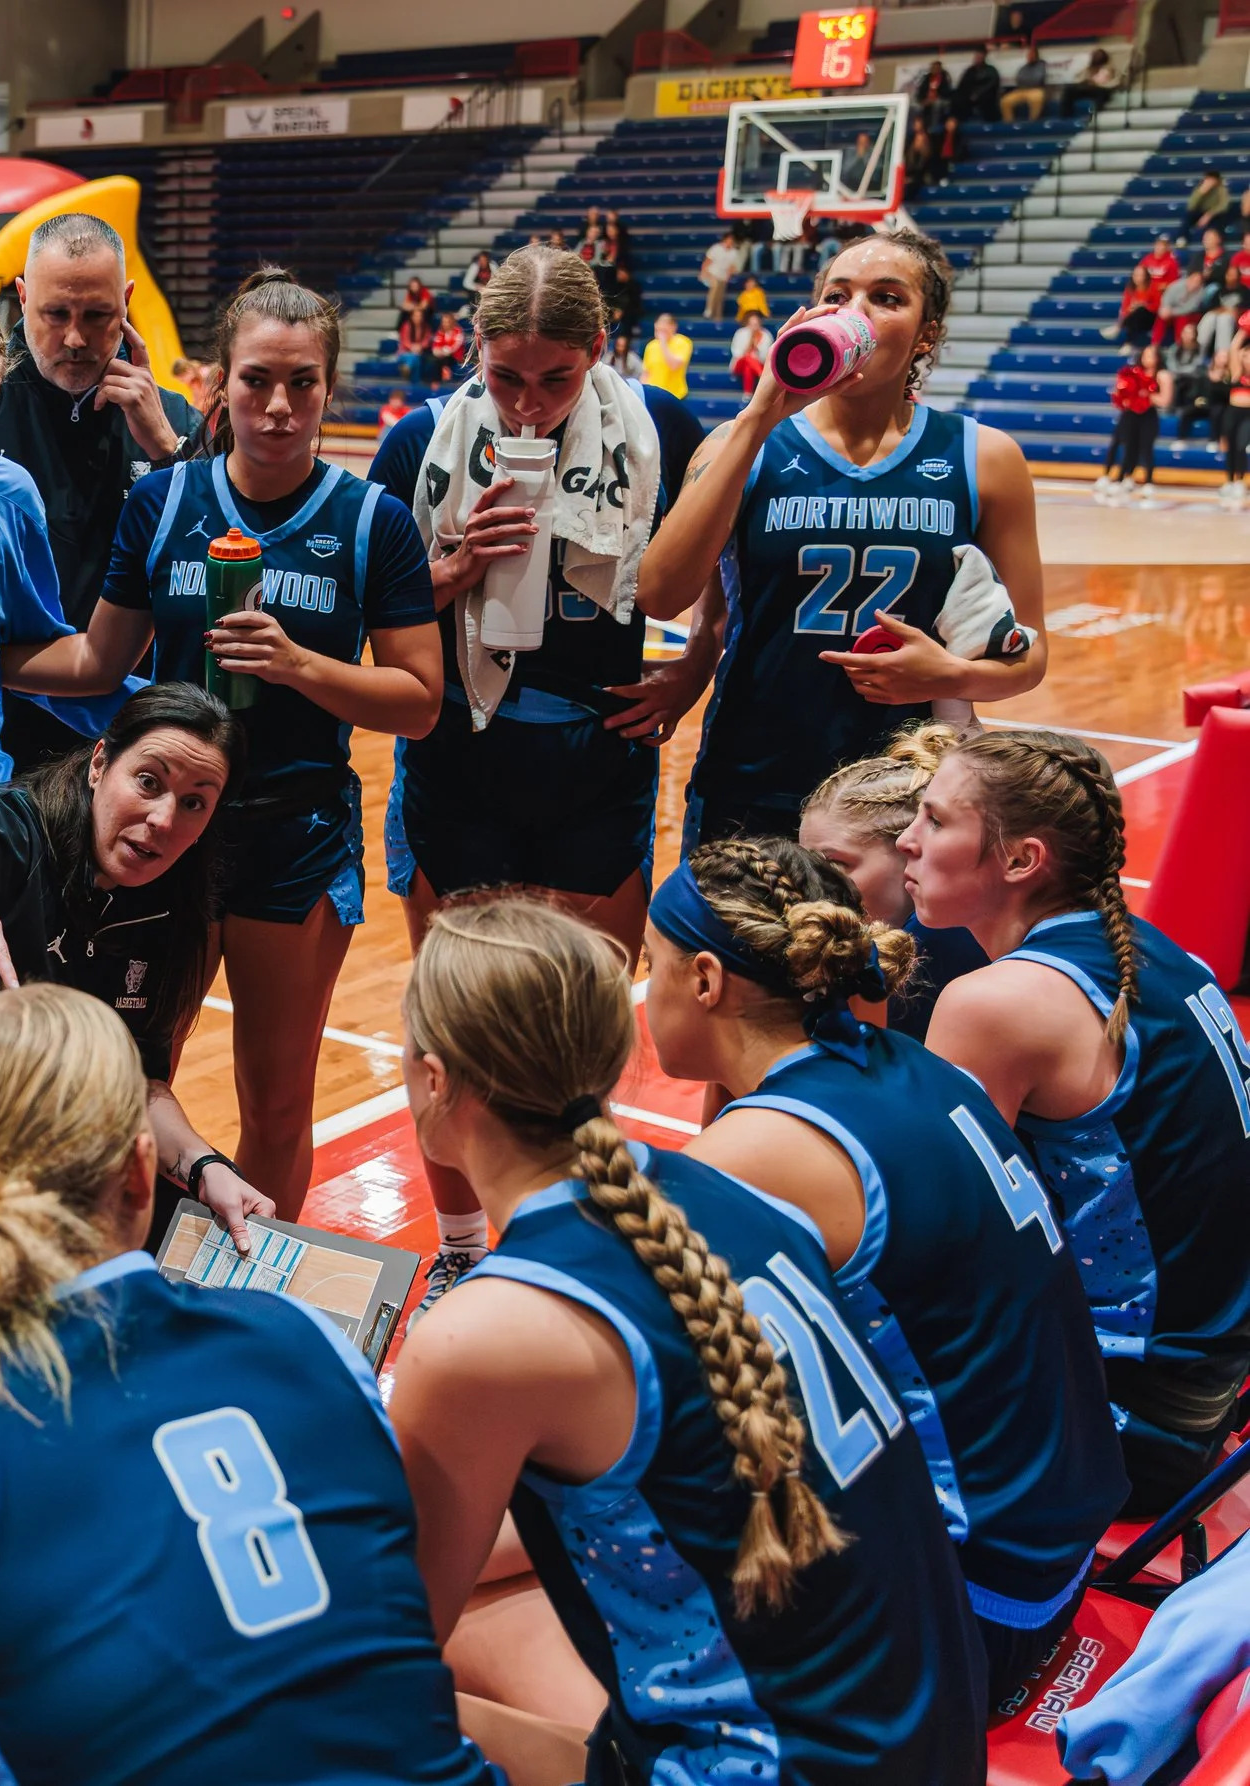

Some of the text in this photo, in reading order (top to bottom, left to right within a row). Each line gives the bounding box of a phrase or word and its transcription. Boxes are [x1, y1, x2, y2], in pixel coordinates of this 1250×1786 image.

[821, 40, 852, 79] 16
[765, 496, 955, 536] NORTHWOOD
[169, 561, 337, 614] NOWOOD
[793, 544, 921, 637] 22
[949, 1104, 1063, 1255] 4
[740, 1251, 906, 1490] 21
[152, 1406, 330, 1639] 8
